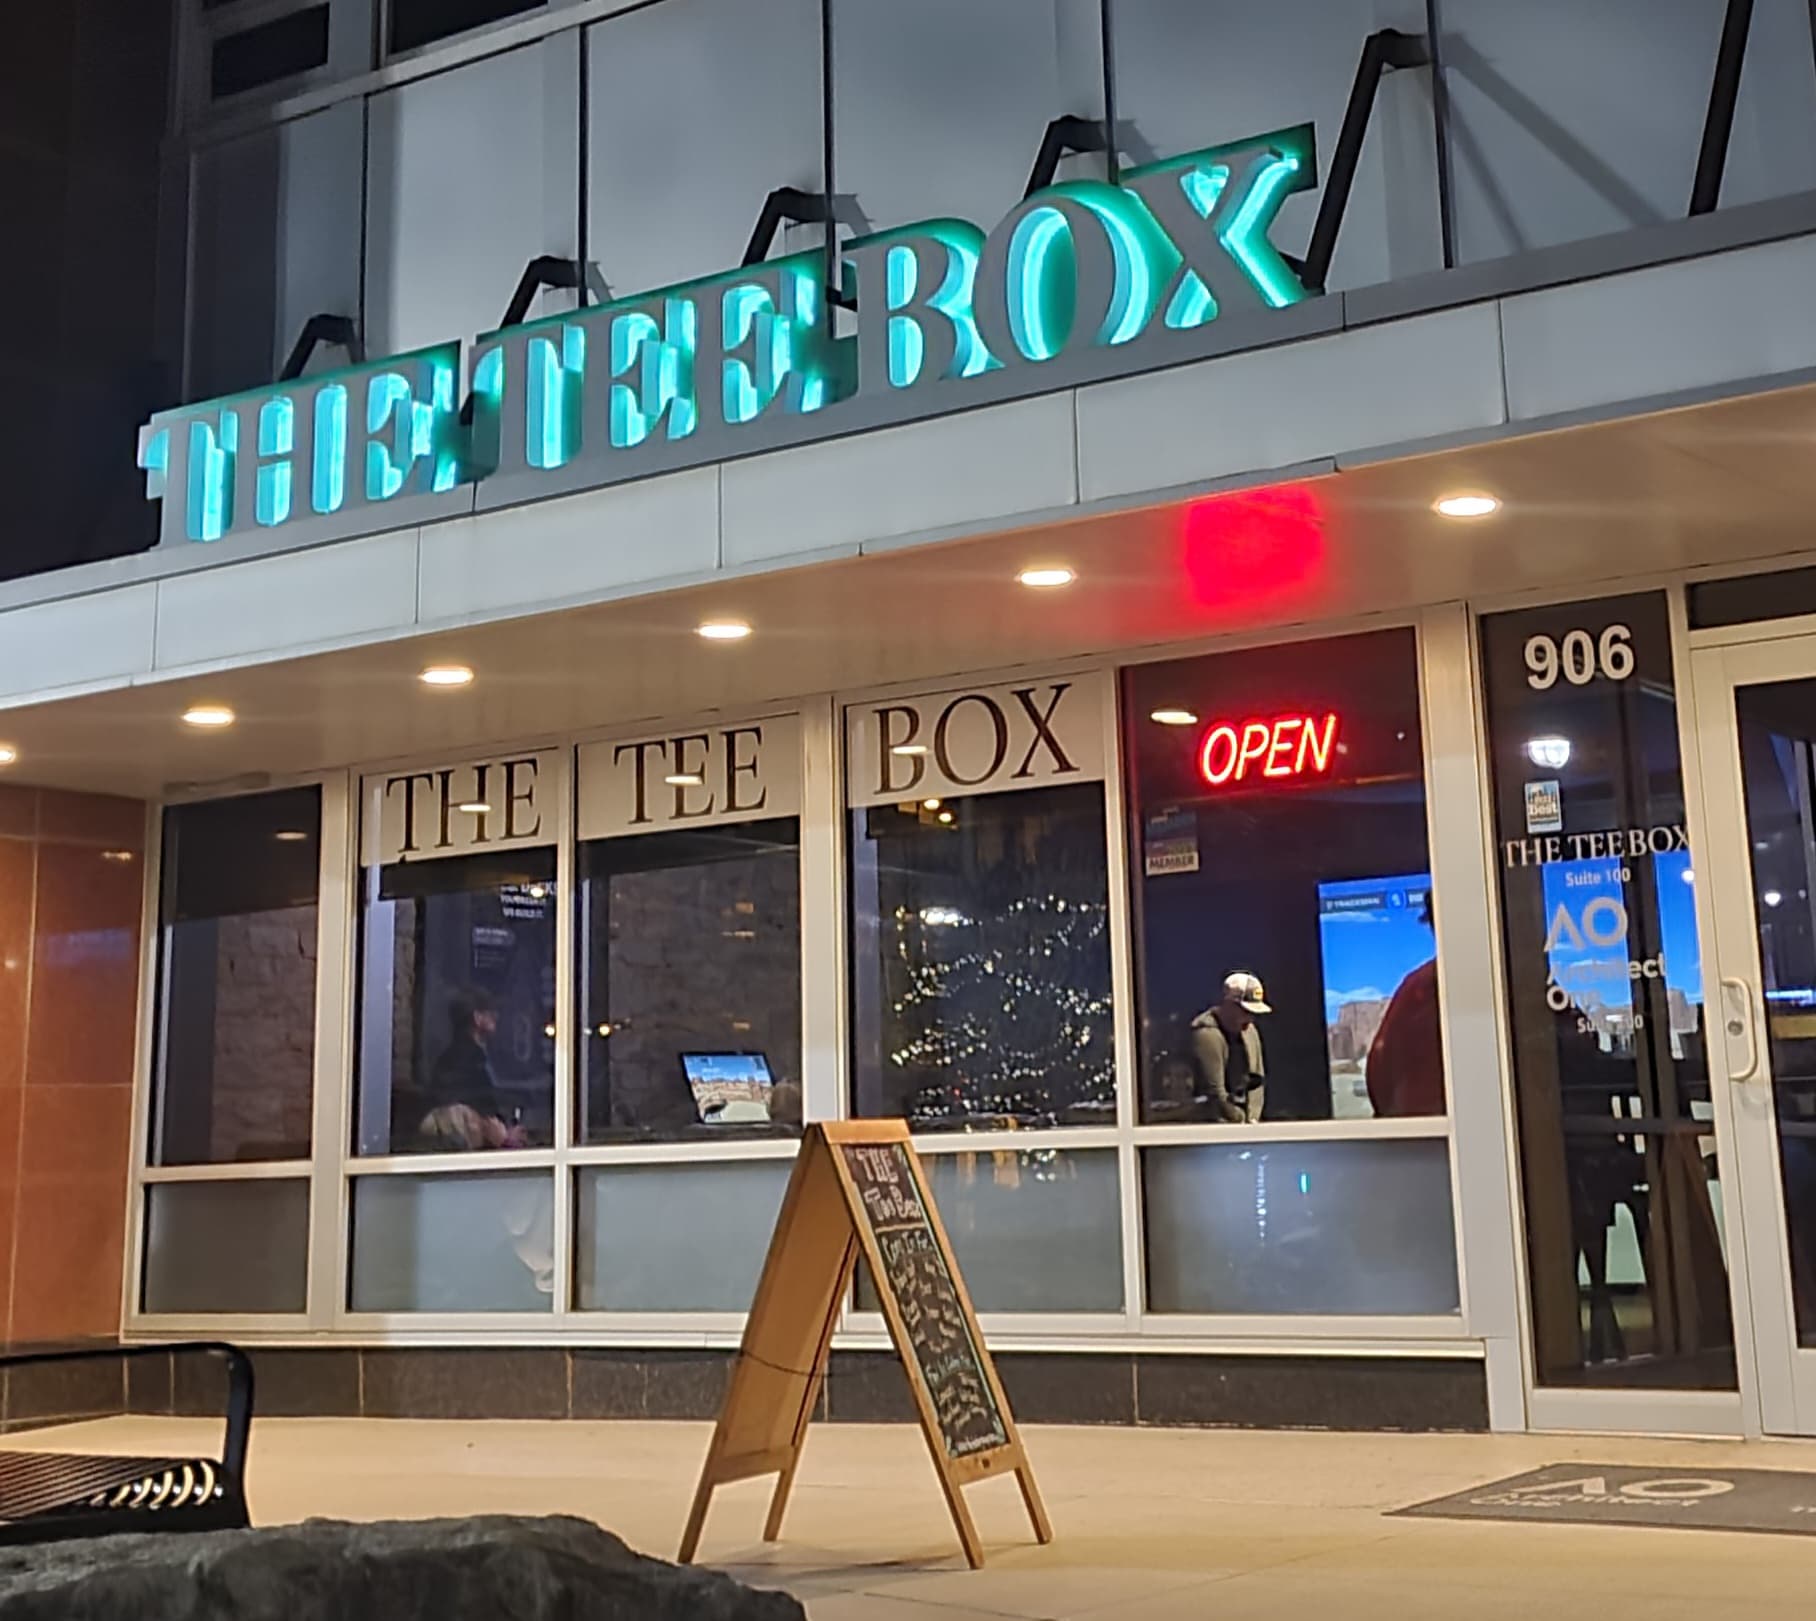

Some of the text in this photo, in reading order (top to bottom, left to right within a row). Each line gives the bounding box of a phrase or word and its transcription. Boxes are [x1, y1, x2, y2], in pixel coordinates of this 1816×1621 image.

[138, 125, 1316, 543] THE TEE BOX
[1524, 624, 1634, 690] 906
[386, 683, 1080, 854] THE TEE BOX
[1201, 714, 1338, 786] OPEN
[1506, 824, 1690, 868] THE TEE BOX
[1565, 866, 1632, 888] Suite 100
